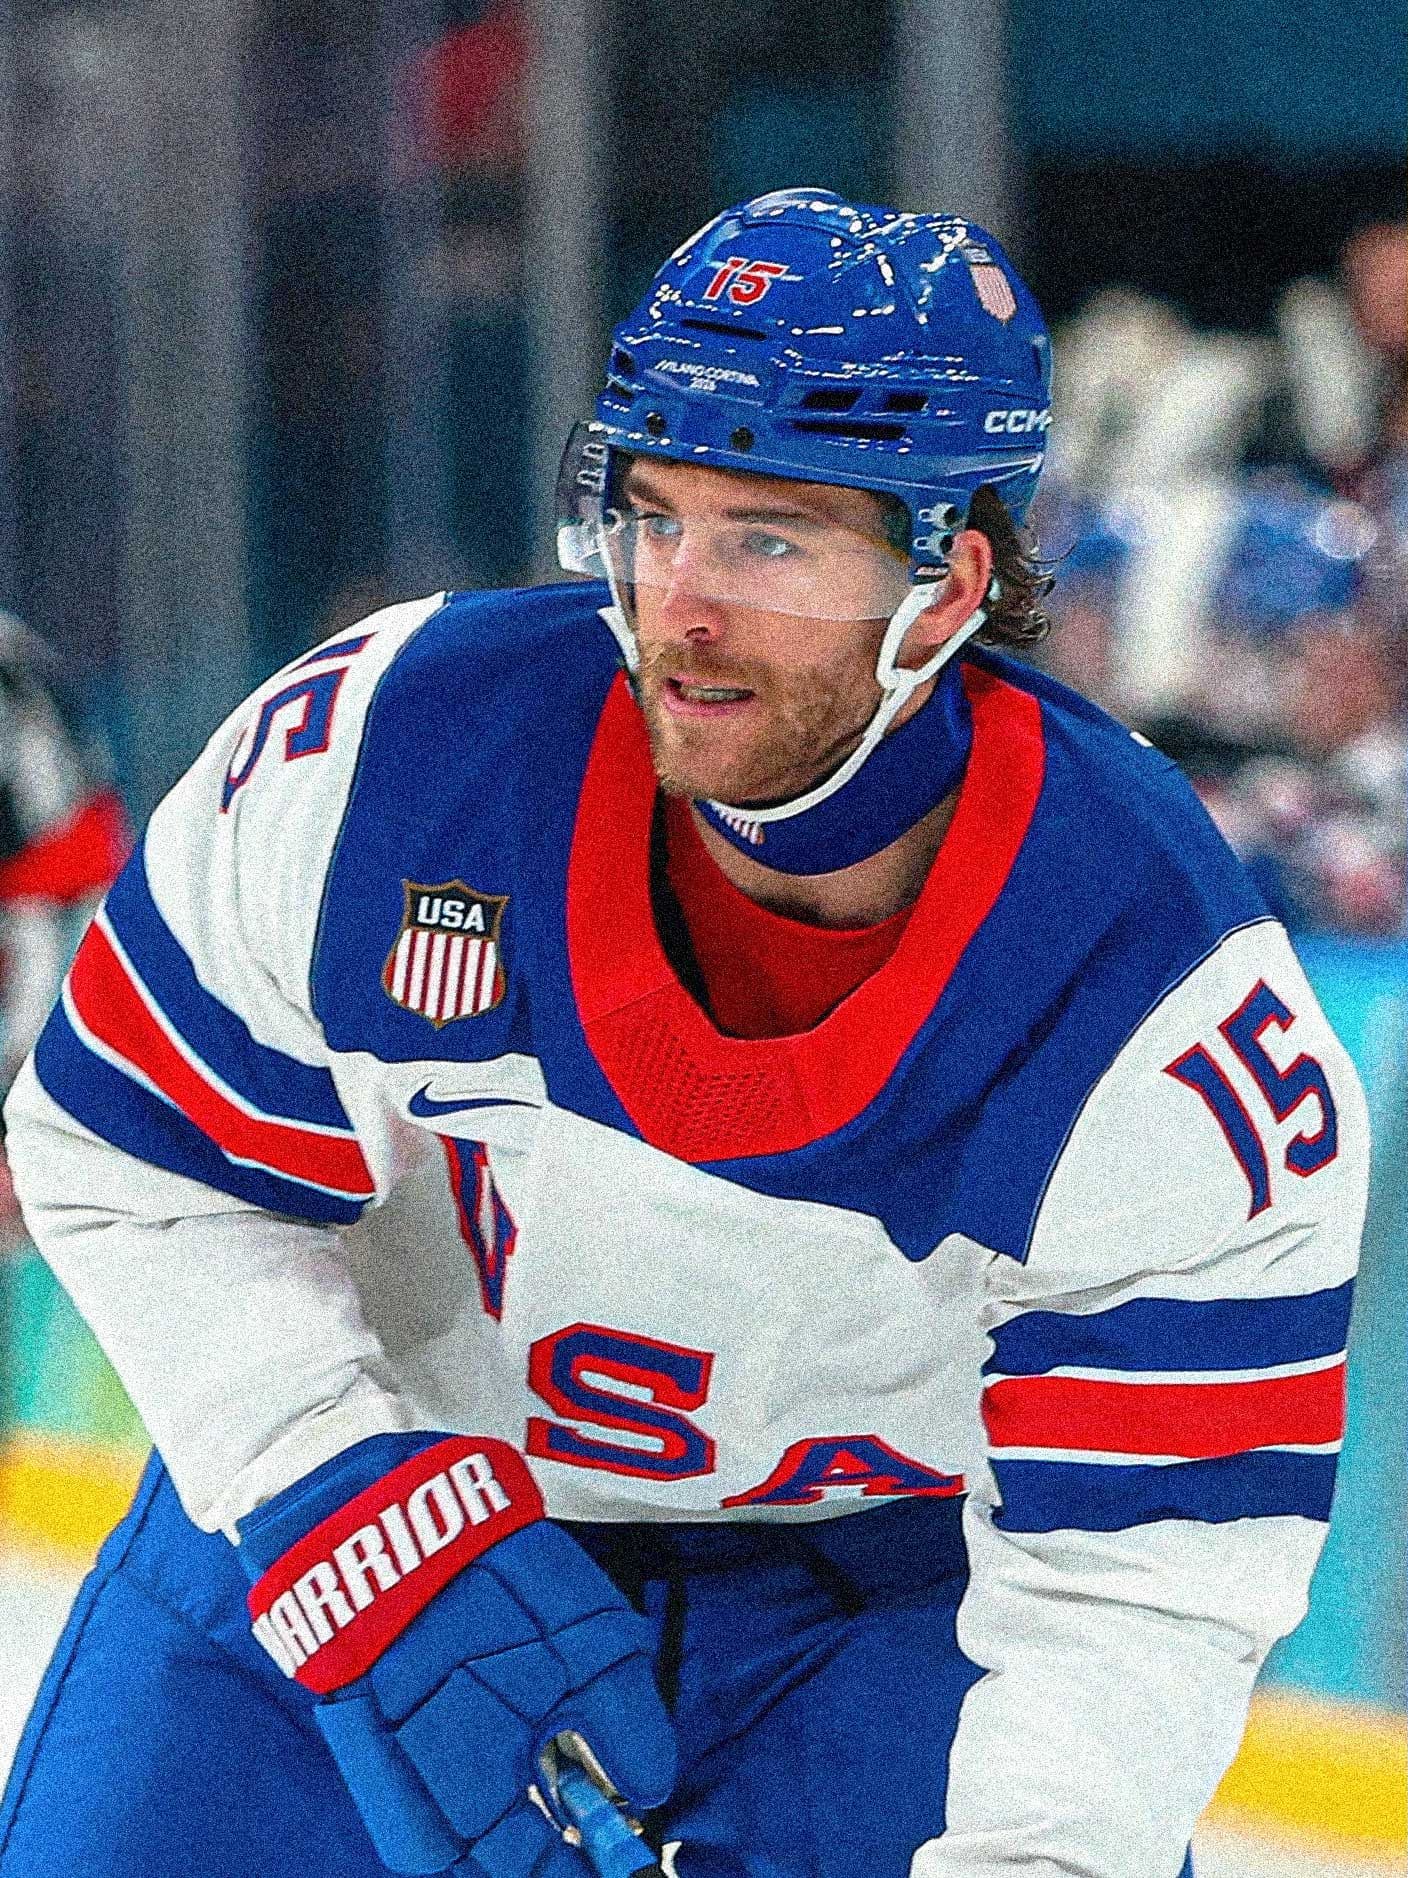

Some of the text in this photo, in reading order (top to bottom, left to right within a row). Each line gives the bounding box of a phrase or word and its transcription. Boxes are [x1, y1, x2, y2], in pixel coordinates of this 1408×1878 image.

[702, 256, 790, 306] 15
[417, 896, 486, 933] USA
[1162, 978, 1339, 1222] 15
